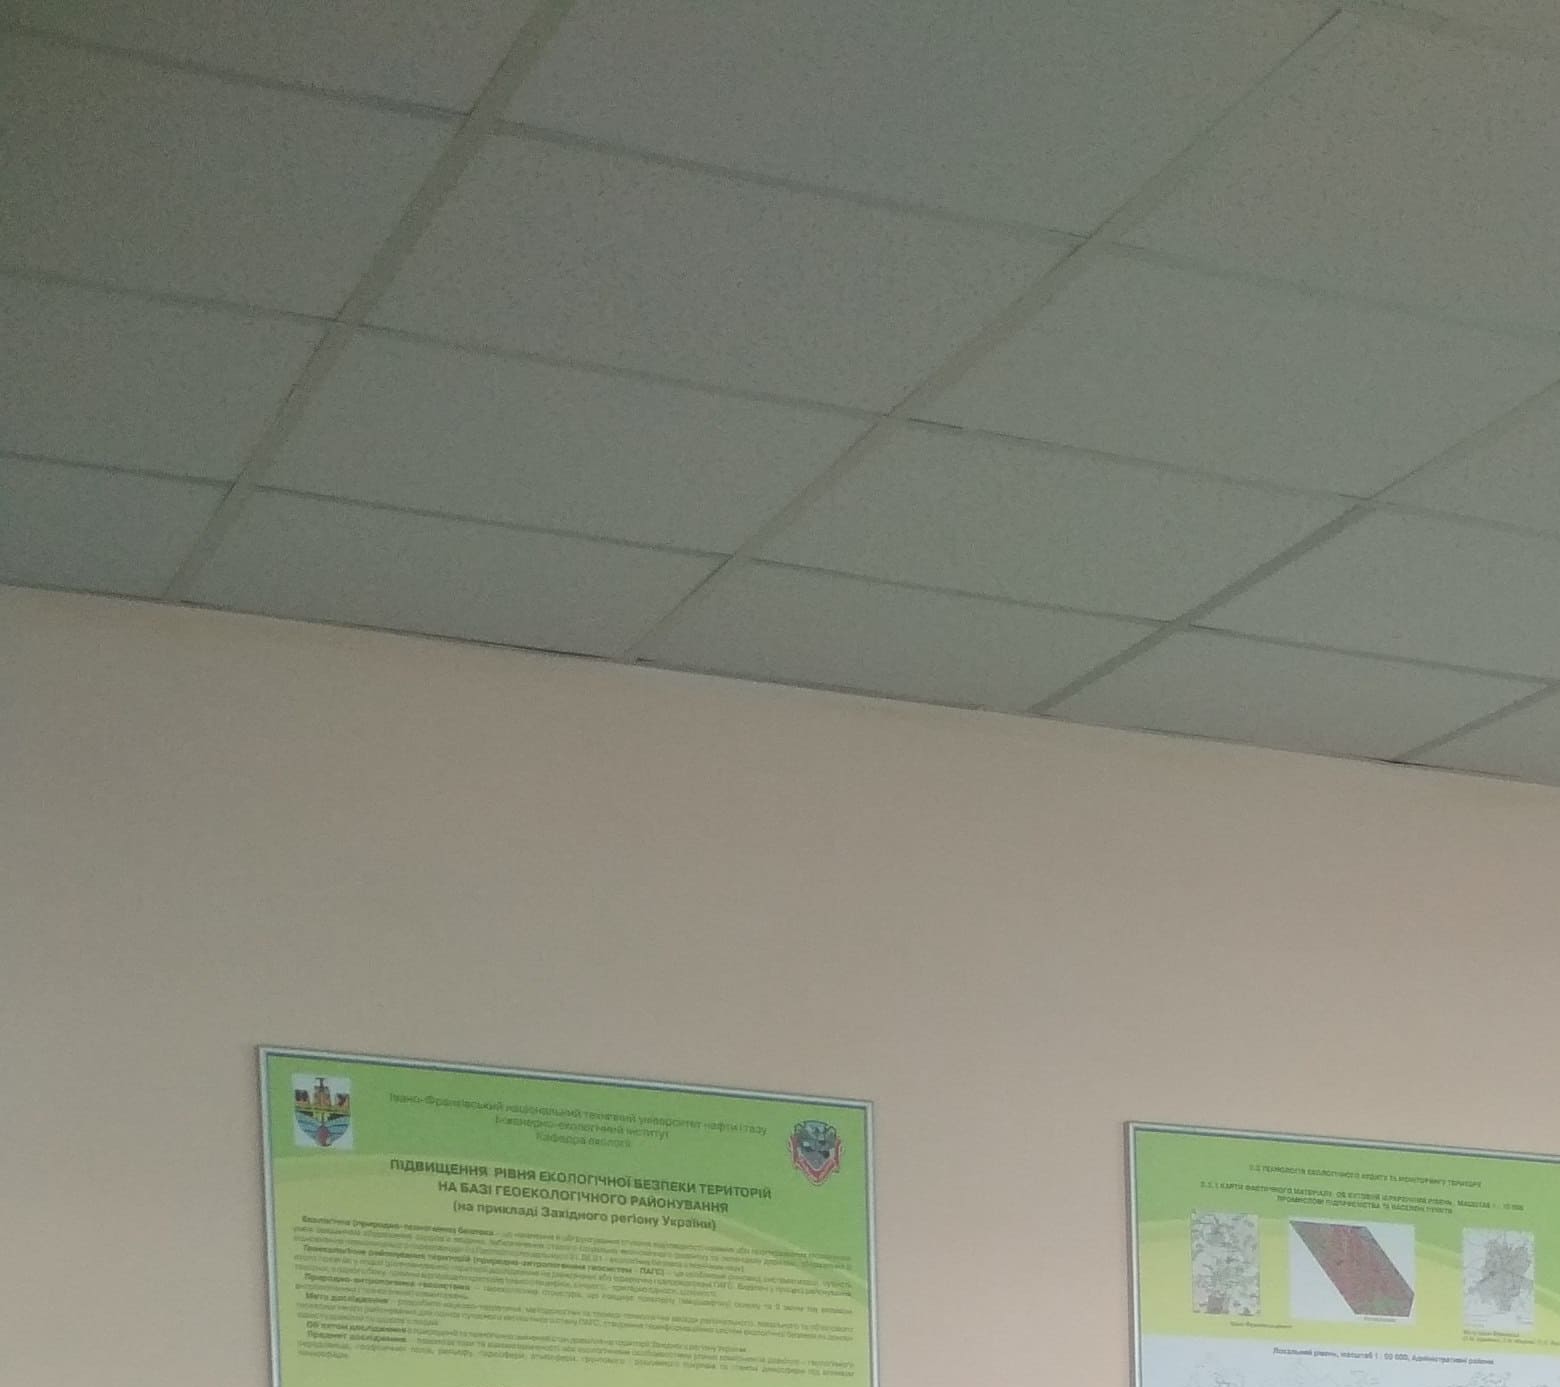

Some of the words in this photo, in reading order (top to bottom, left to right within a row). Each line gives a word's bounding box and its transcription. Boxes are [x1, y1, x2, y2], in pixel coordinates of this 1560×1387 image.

[390, 1160, 488, 1177] ПІДВИЩЕННЯ
[495, 1167, 536, 1181] РІВНЯ
[540, 1172, 631, 1188] ЕКОЛОГІЧНОЇ
[634, 1179, 696, 1193] БЕЗПЕКИ
[699, 1184, 772, 1199] ТЕРИТОРІЙ
[439, 1182, 457, 1193] НА
[461, 1183, 492, 1195] БАЗІ
[496, 1186, 627, 1205] ГЕОЕКОЛОГІЧНОГО
[631, 1195, 729, 1213] РАЙОНУВАННЯ
[453, 1201, 474, 1213] (на
[477, 1203, 538, 1218] прикладі
[541, 1206, 608, 1221] Західного
[611, 1213, 658, 1227] регіону
[662, 1215, 716, 1230] України)
